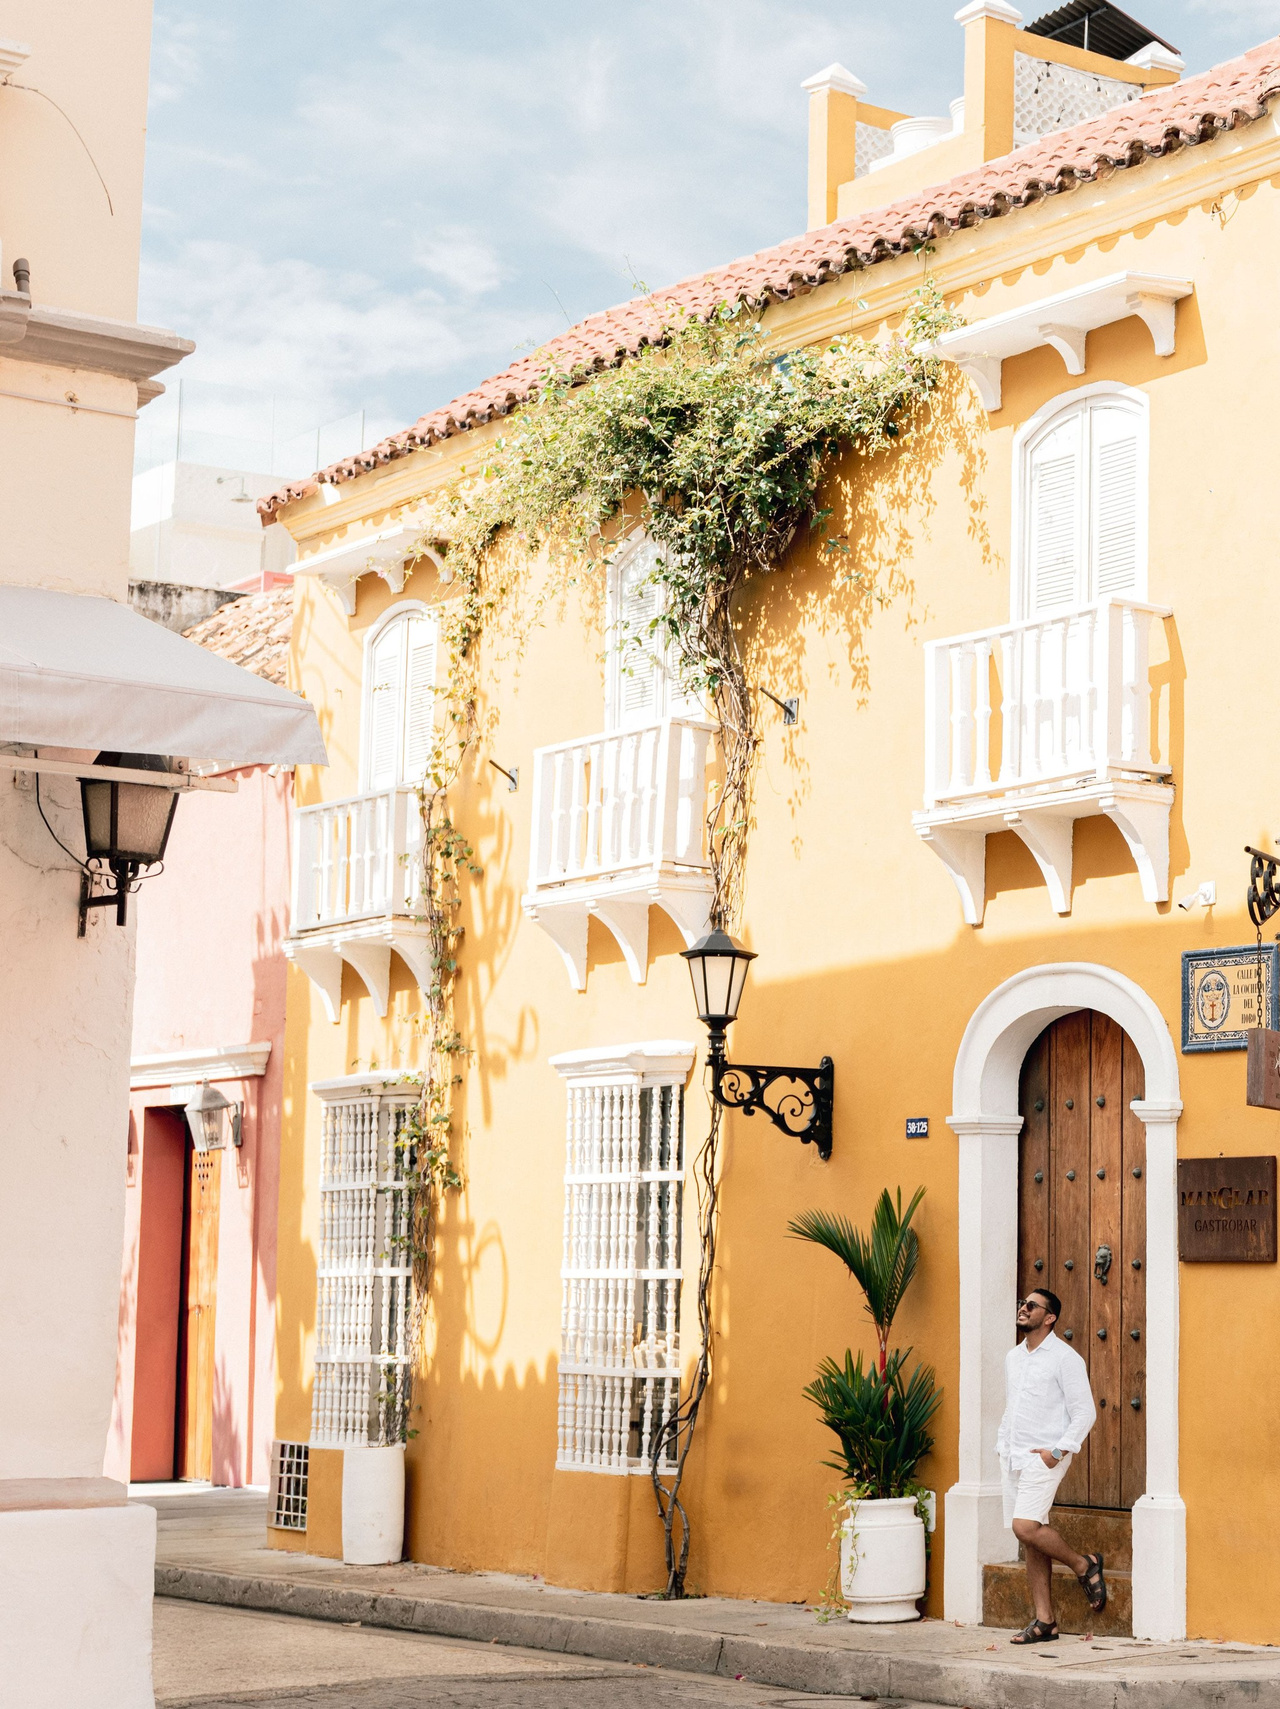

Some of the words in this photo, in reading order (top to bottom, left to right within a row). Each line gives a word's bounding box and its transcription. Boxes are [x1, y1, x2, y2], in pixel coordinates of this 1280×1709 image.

[1237, 969, 1252, 979] CALLE
[1233, 984, 1240, 995] LA
[1243, 999, 1253, 1009] DEL
[1241, 1014, 1256, 1024] HOBO
[907, 1121, 928, 1134] 38-125
[1181, 1187, 1269, 1210] MANGLAR
[1194, 1219, 1257, 1231] GASTROBAR
